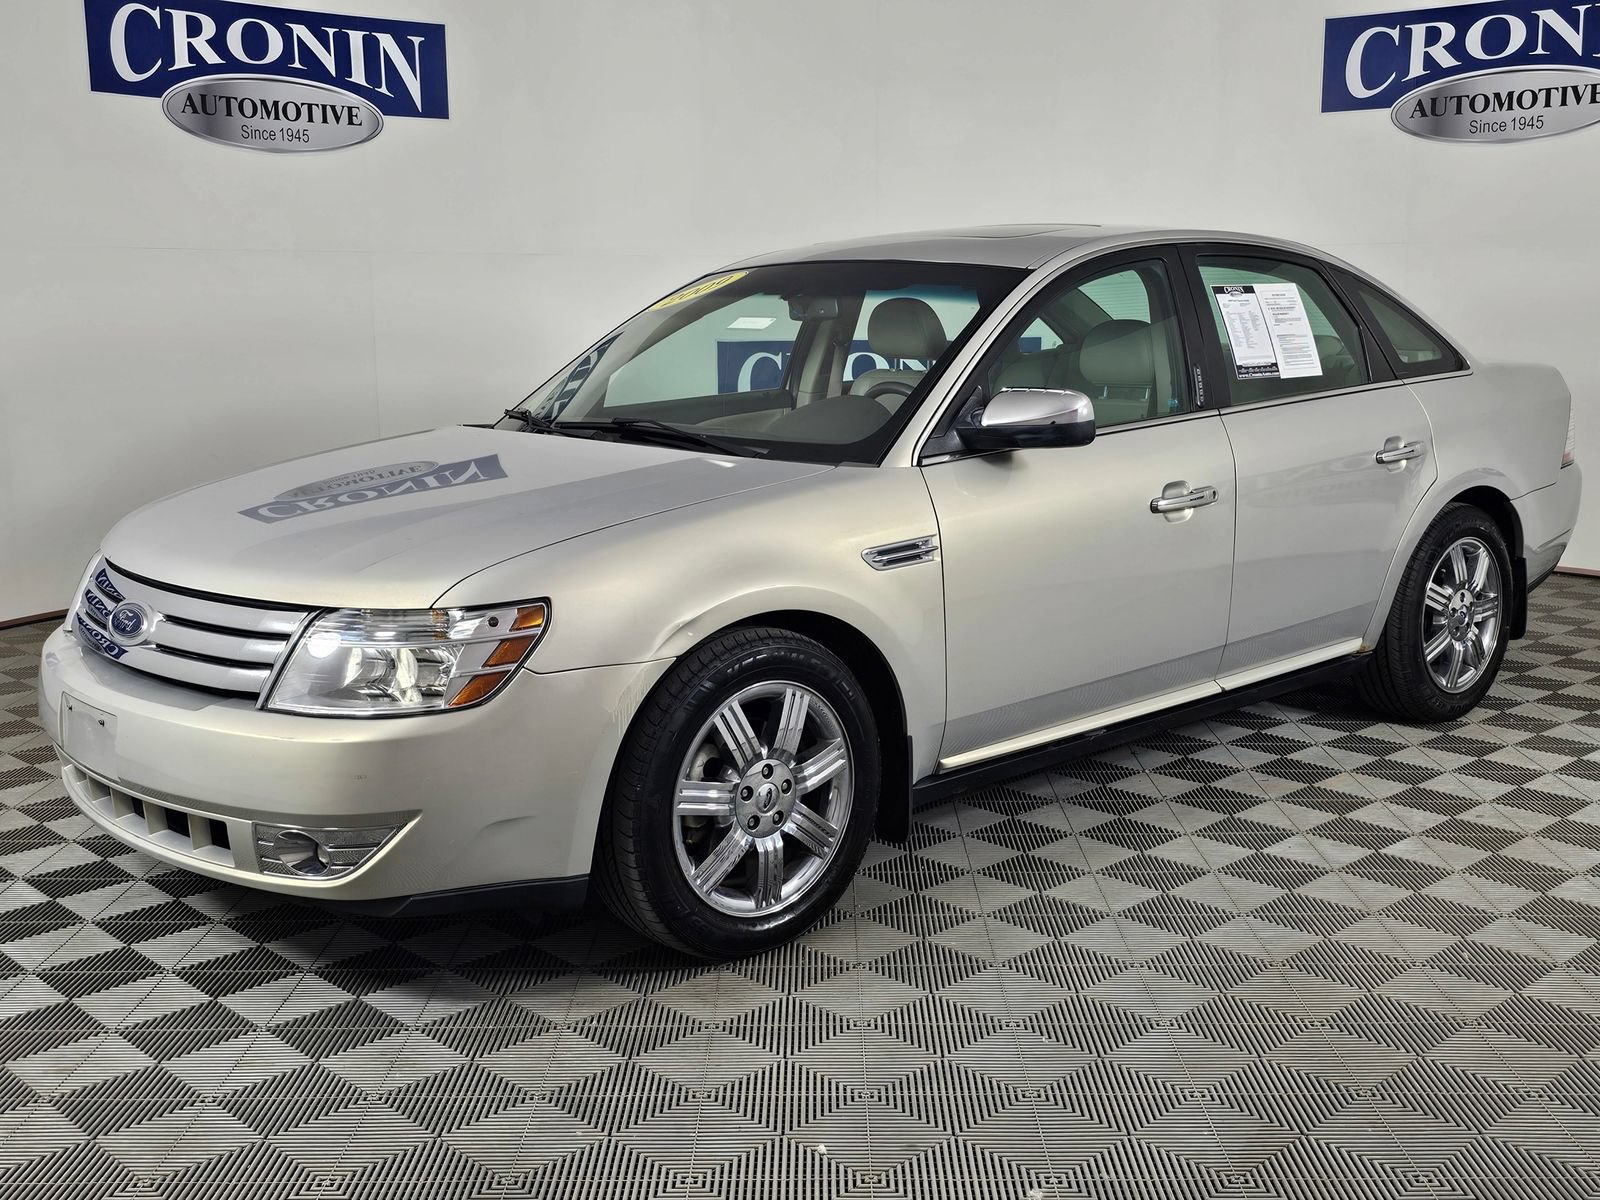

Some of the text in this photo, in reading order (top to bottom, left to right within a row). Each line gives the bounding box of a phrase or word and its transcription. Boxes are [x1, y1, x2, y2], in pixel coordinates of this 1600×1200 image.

[110, 2, 425, 113] CRONIN
[1345, 3, 1600, 99] CRON
[181, 92, 363, 127] AUTOMOTIVE
[241, 124, 310, 143] Since 1945
[1469, 115, 1544, 134] Since 1945
[119, 609, 137, 632] Ford
